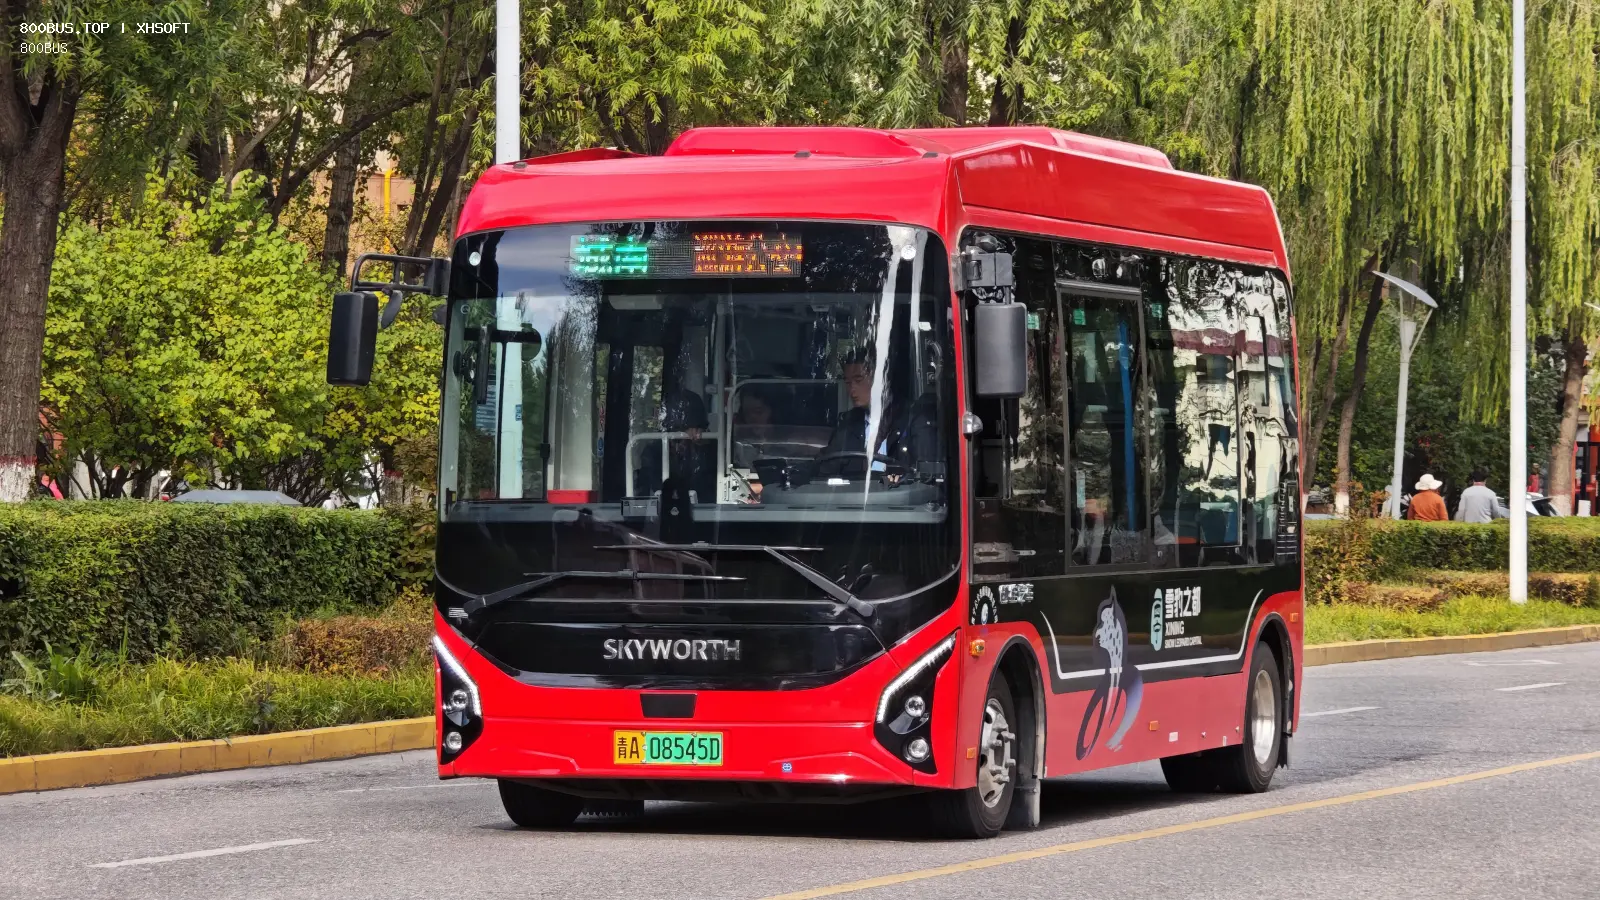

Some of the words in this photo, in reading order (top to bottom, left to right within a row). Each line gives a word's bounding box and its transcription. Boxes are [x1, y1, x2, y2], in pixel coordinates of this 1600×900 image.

[1165, 586, 1201, 618] 雪豹之都
[603, 638, 741, 661] SKYWORTH
